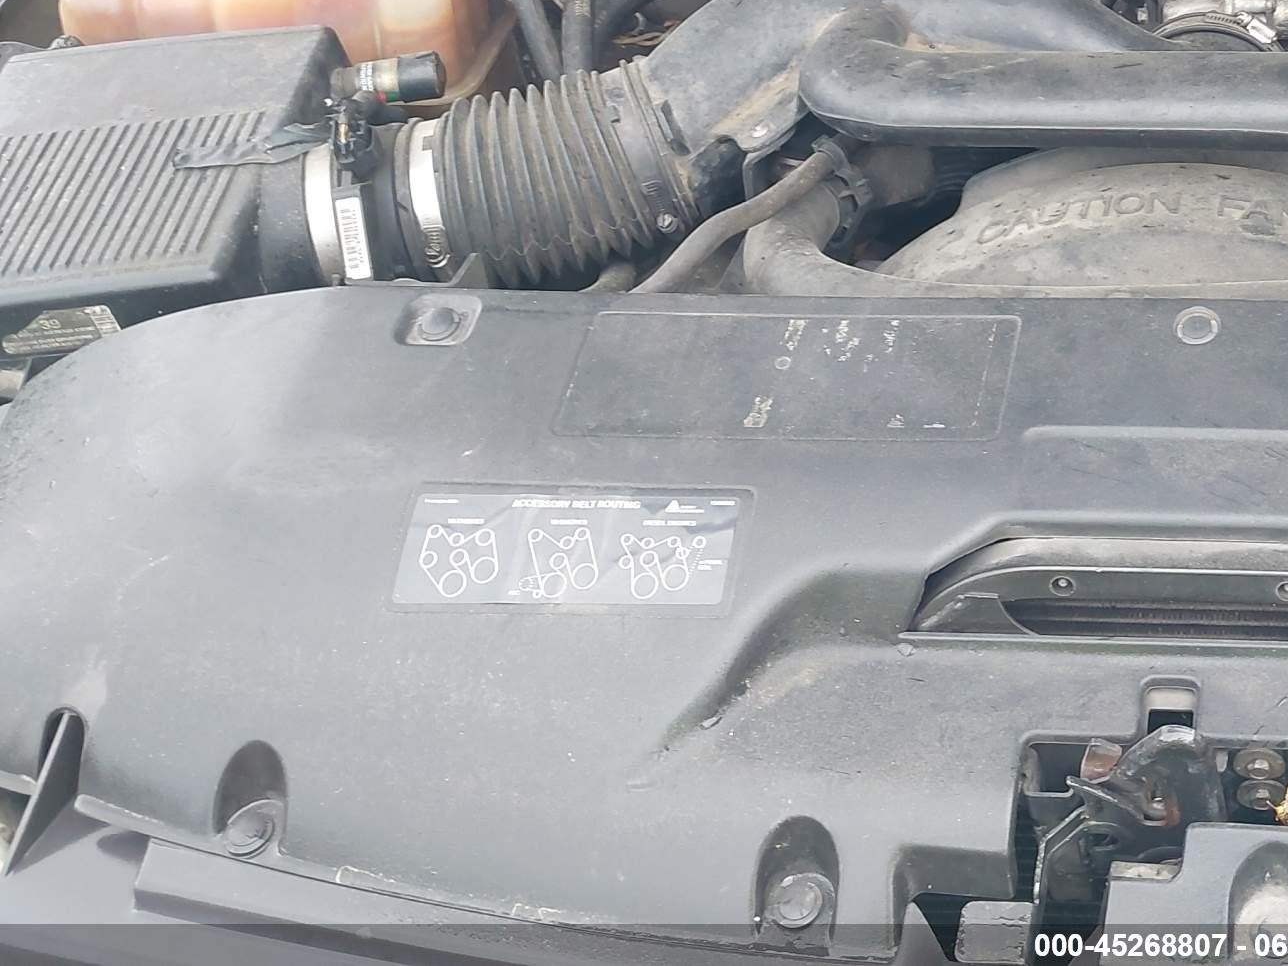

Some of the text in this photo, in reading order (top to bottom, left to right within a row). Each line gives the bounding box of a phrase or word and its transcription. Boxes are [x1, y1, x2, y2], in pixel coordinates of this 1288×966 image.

[977, 191, 1180, 245] CAUTION
[38, 318, 62, 330] 39
[511, 499, 642, 509] ACCESSORY BELT ROUTING
